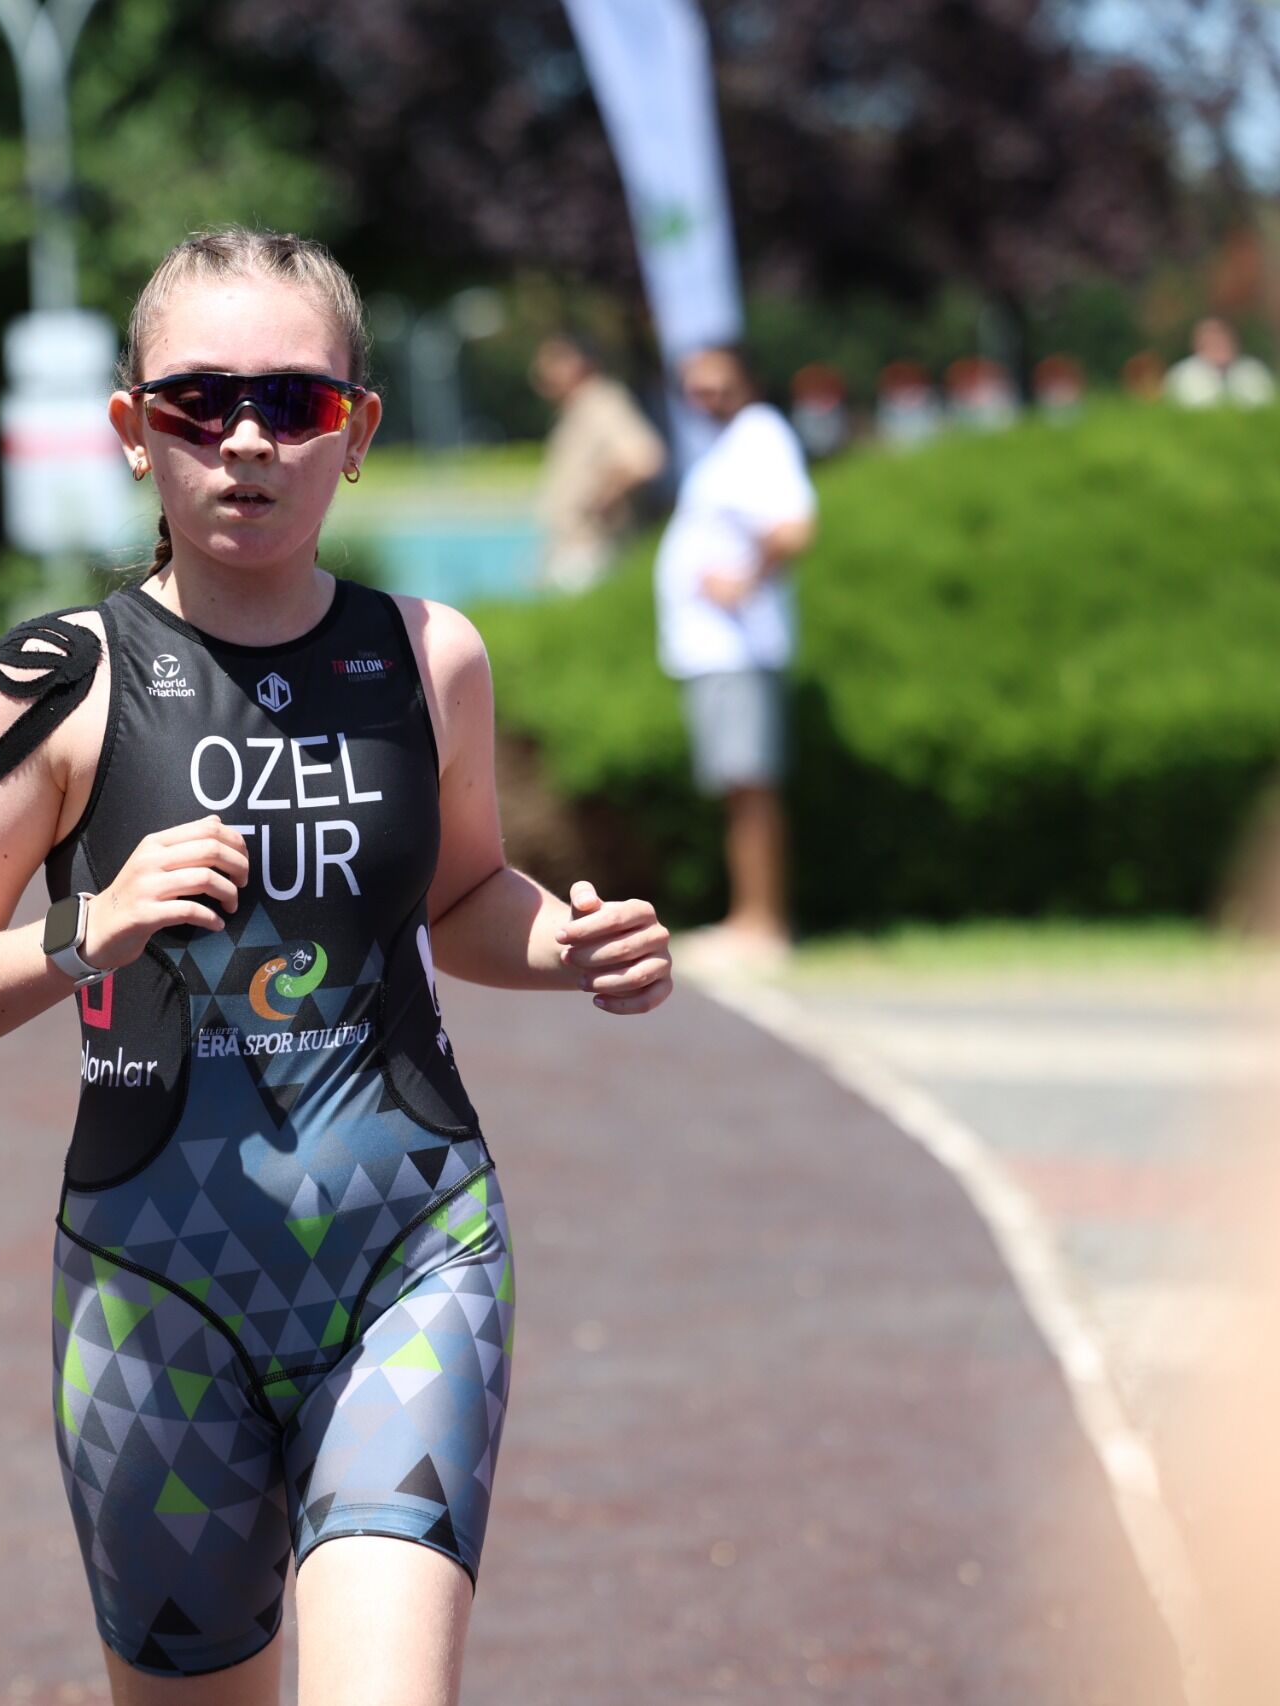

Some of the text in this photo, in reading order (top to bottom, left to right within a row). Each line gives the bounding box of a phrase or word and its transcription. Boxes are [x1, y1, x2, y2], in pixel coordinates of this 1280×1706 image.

[146, 686, 196, 697] Triathlon
[151, 677, 187, 689] World
[190, 732, 383, 811] OZEL
[196, 1018, 371, 1058] ERA SPOR KULÜBÜ
